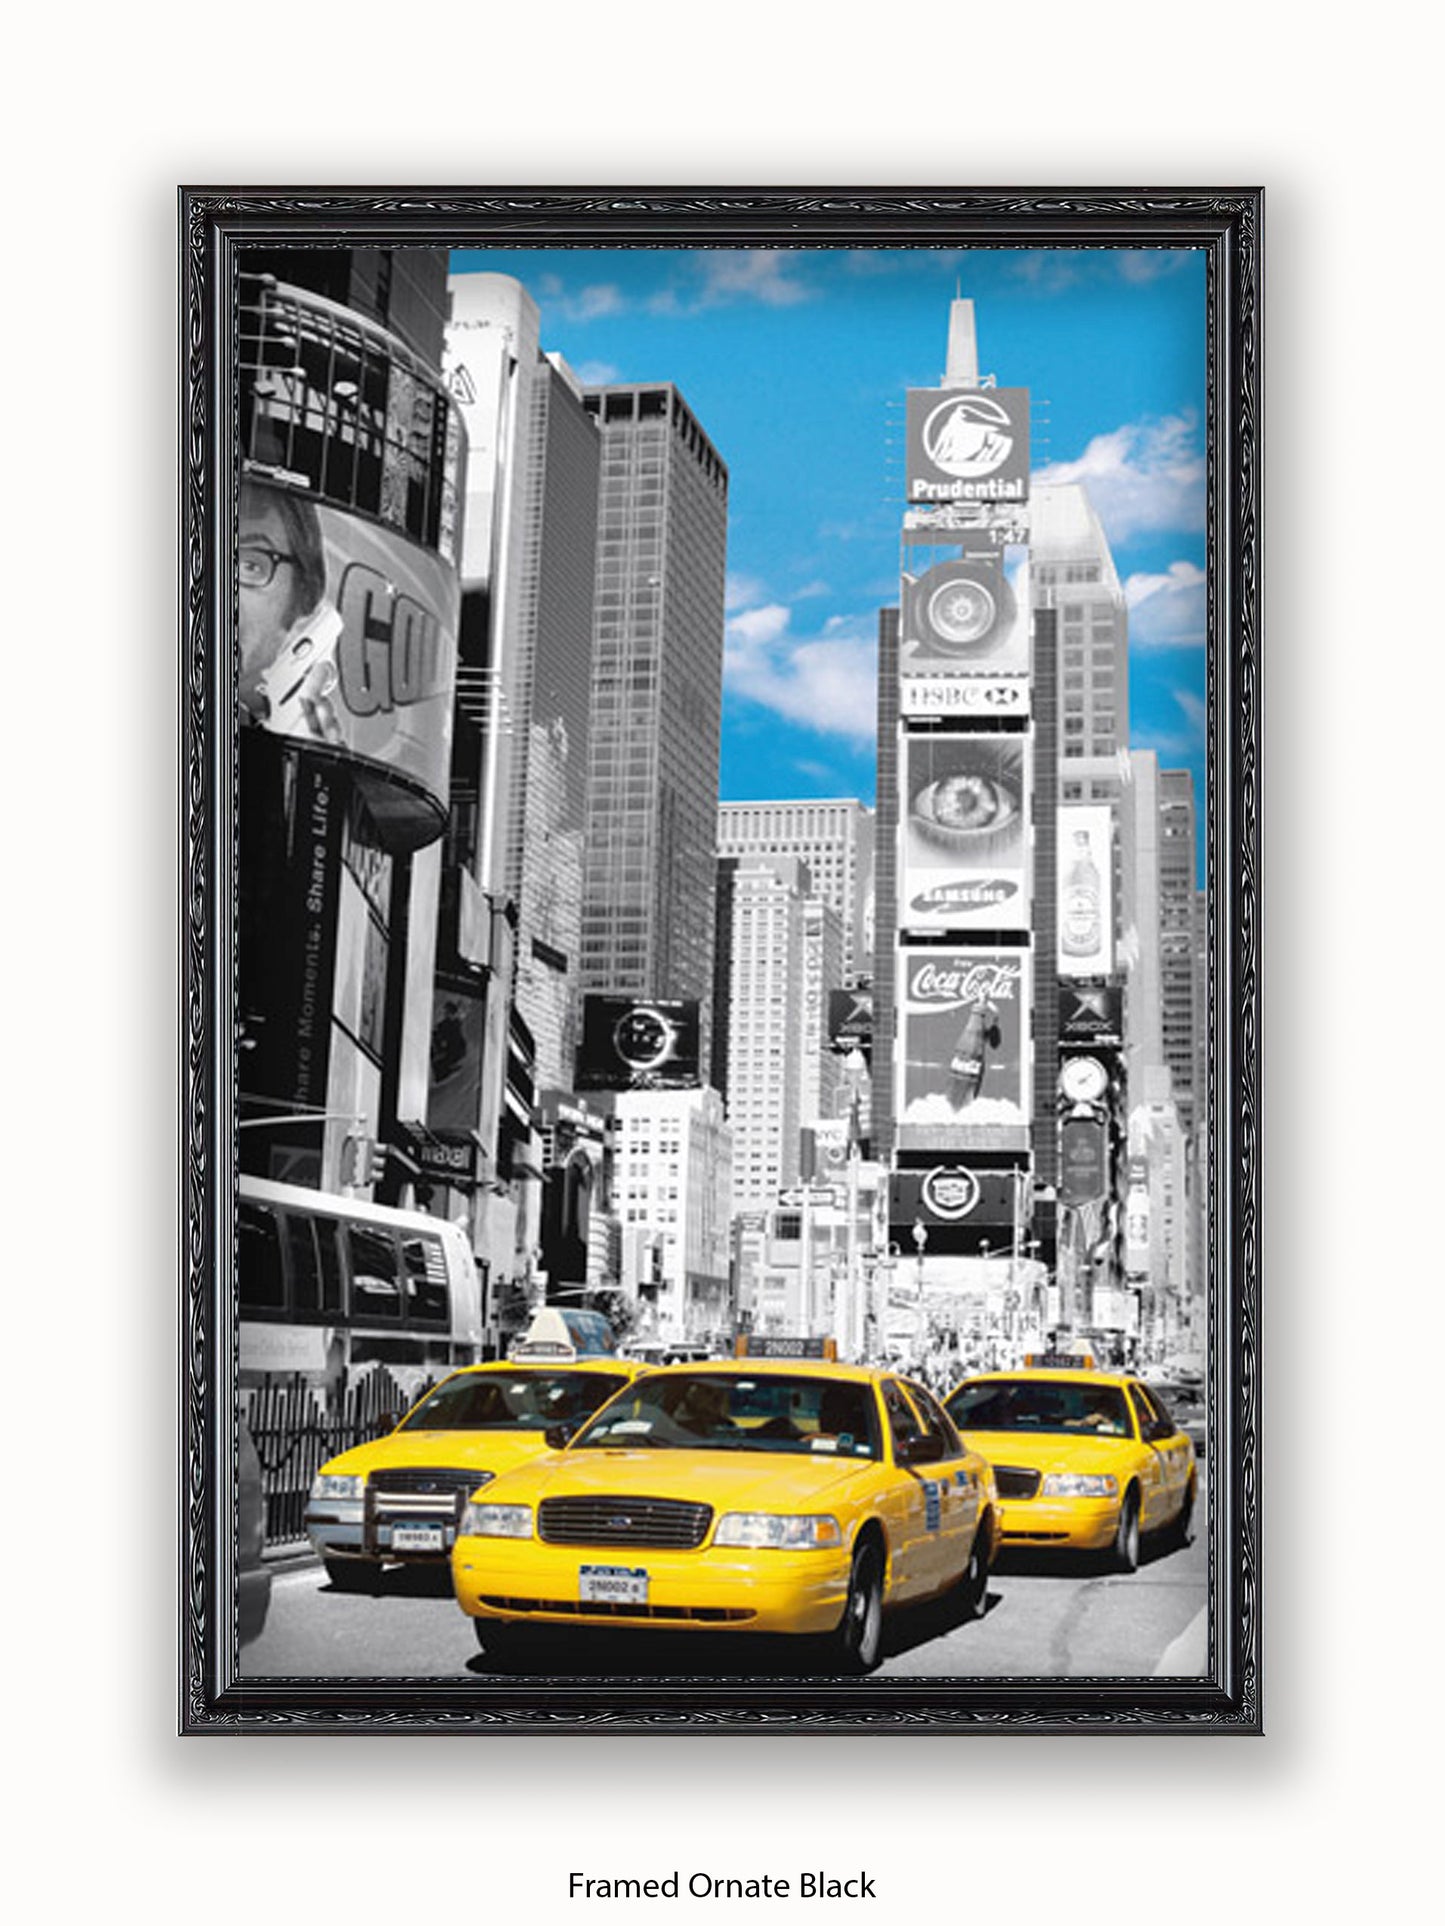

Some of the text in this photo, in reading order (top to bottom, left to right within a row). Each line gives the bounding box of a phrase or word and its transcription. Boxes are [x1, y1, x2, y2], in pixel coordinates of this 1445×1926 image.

[913, 479, 1023, 498] Prudential
[989, 530, 1025, 544] 1:47
[910, 687, 979, 705] HSBC
[306, 844, 327, 913] Share
[921, 888, 1005, 902] SAMSUNG
[911, 962, 1021, 1000] Coca-Cola
[1064, 1021, 1113, 1032] XBOX
